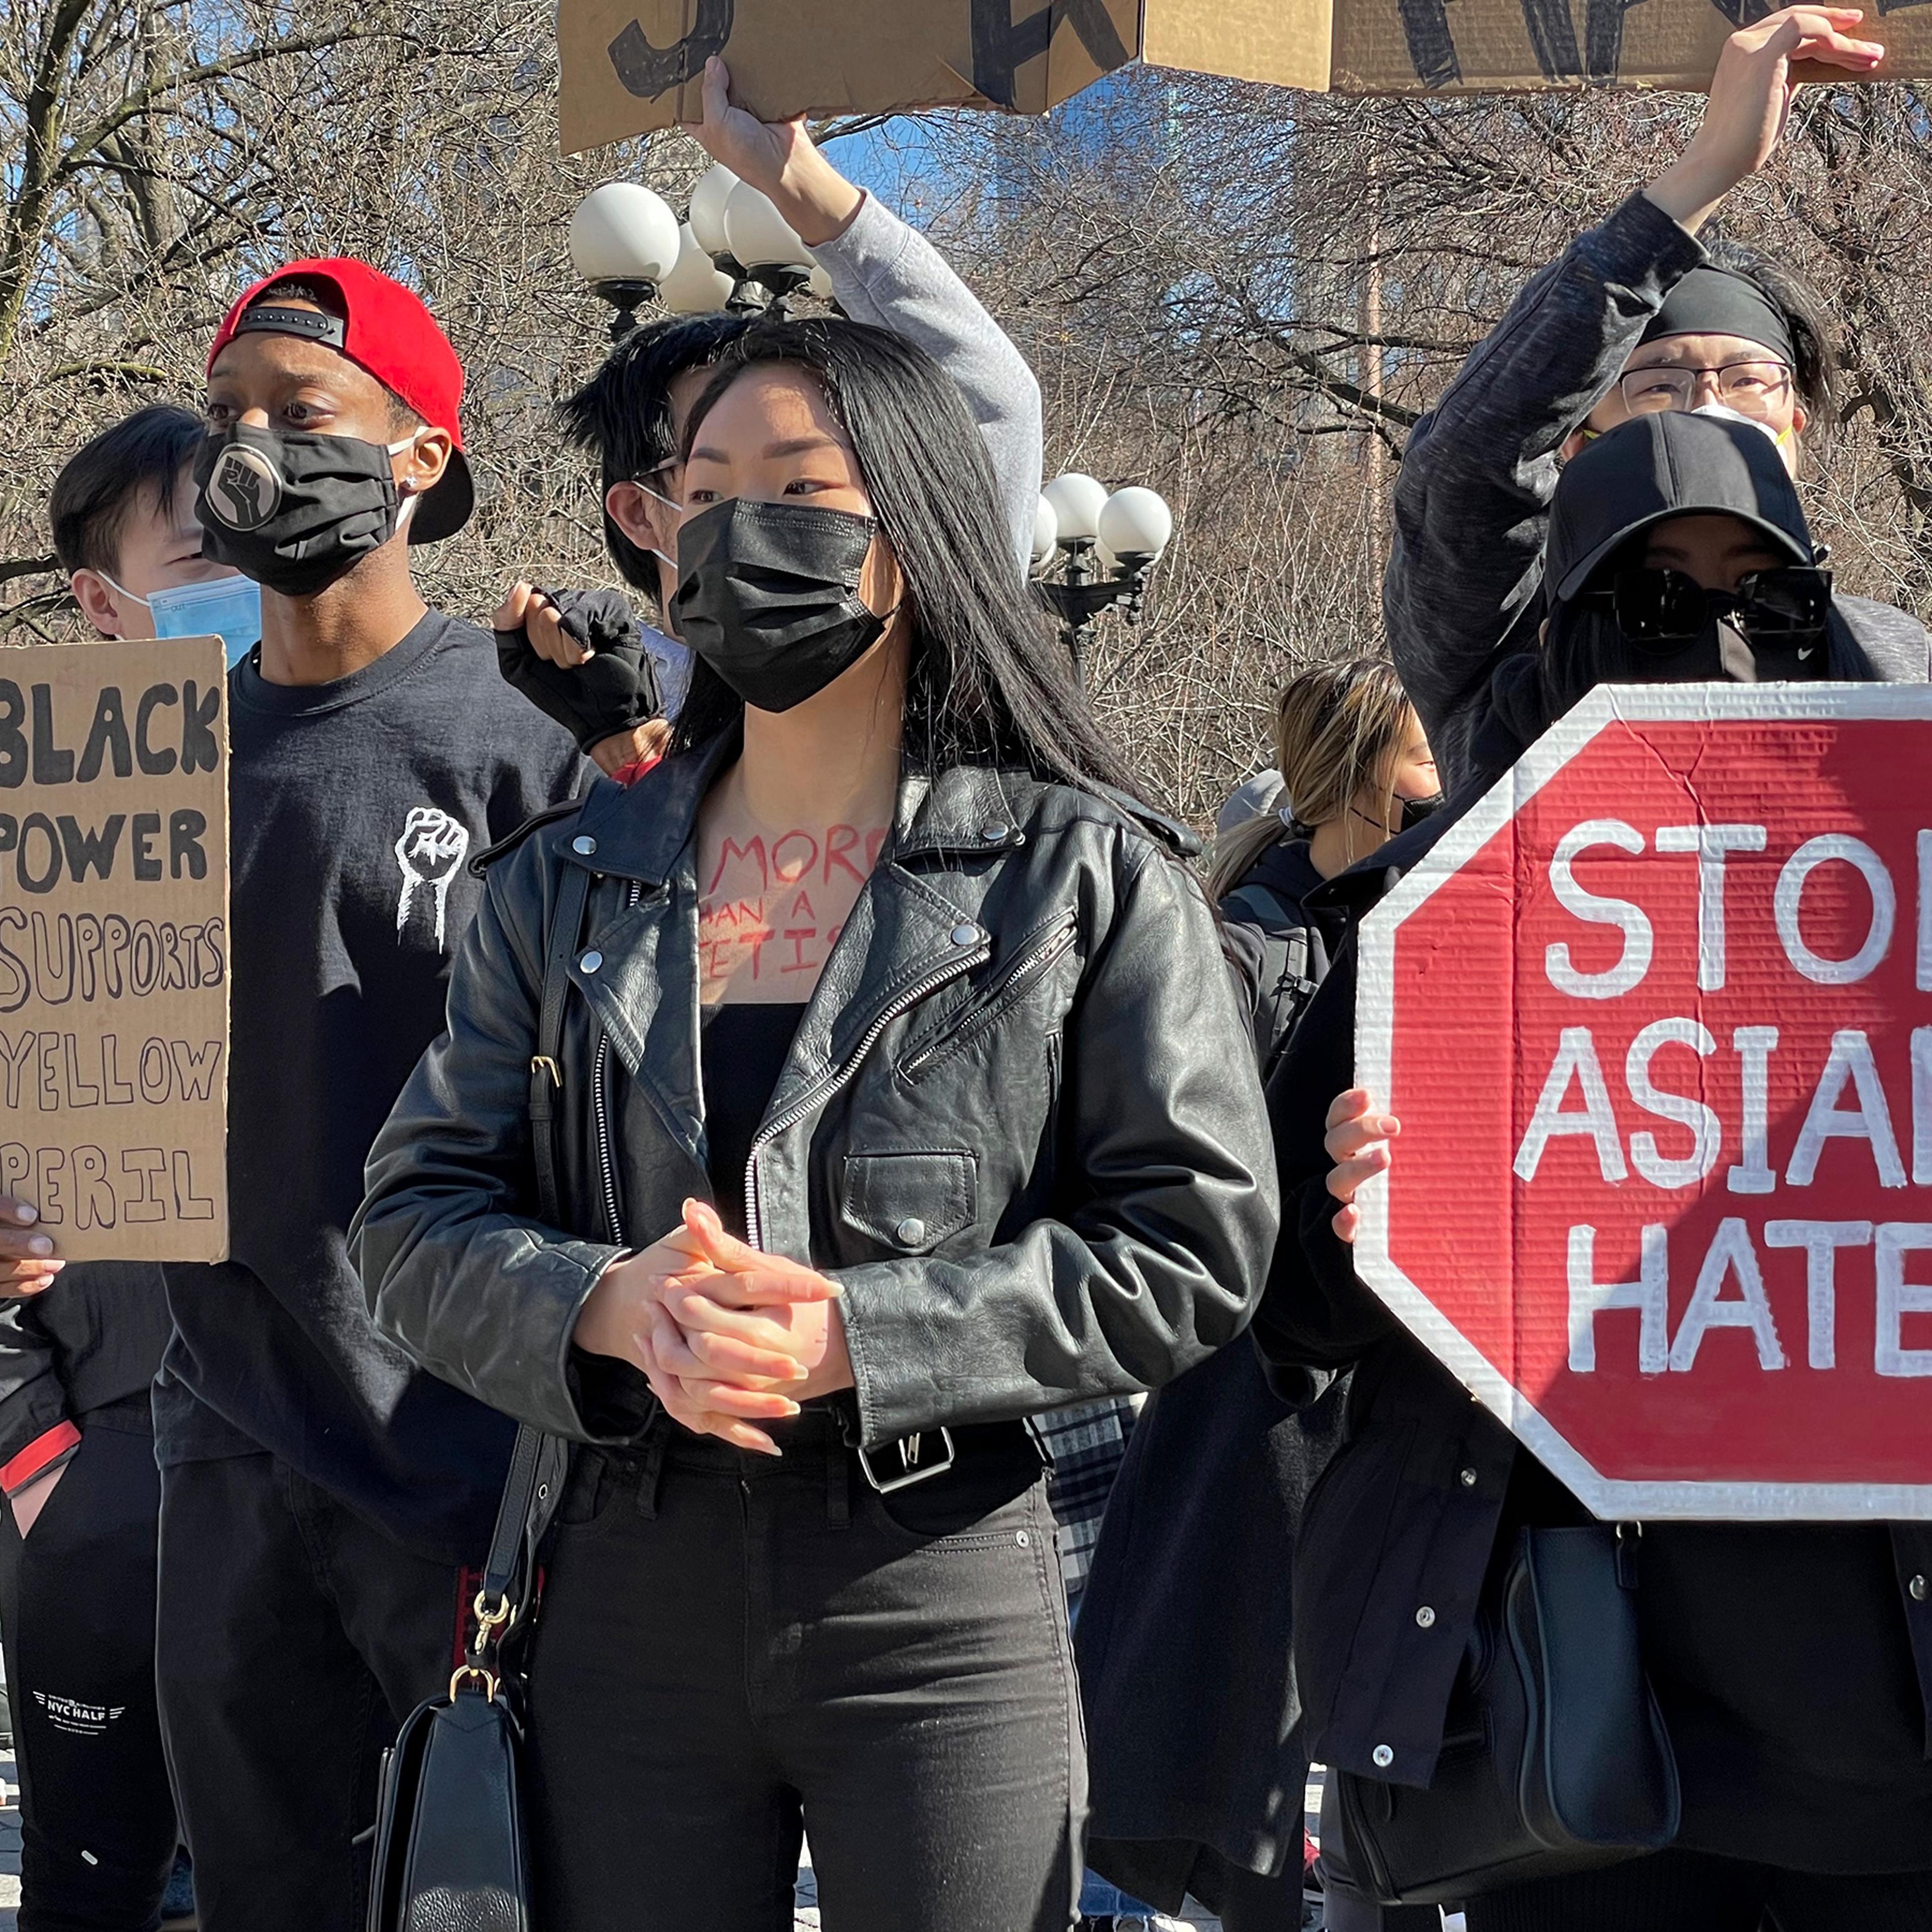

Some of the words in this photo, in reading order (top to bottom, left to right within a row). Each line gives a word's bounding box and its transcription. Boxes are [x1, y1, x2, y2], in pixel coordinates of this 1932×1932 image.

[0, 679, 220, 789] BLACK
[791, 890, 816, 921] A
[1545, 818, 1932, 1000] STO
[0, 906, 224, 1013] SUPPORTS
[0, 1030, 222, 1111] YELLOW
[0, 1142, 214, 1230] PERIL
[48, 1700, 70, 1716] NYC
[72, 1708, 105, 1721] HALF
